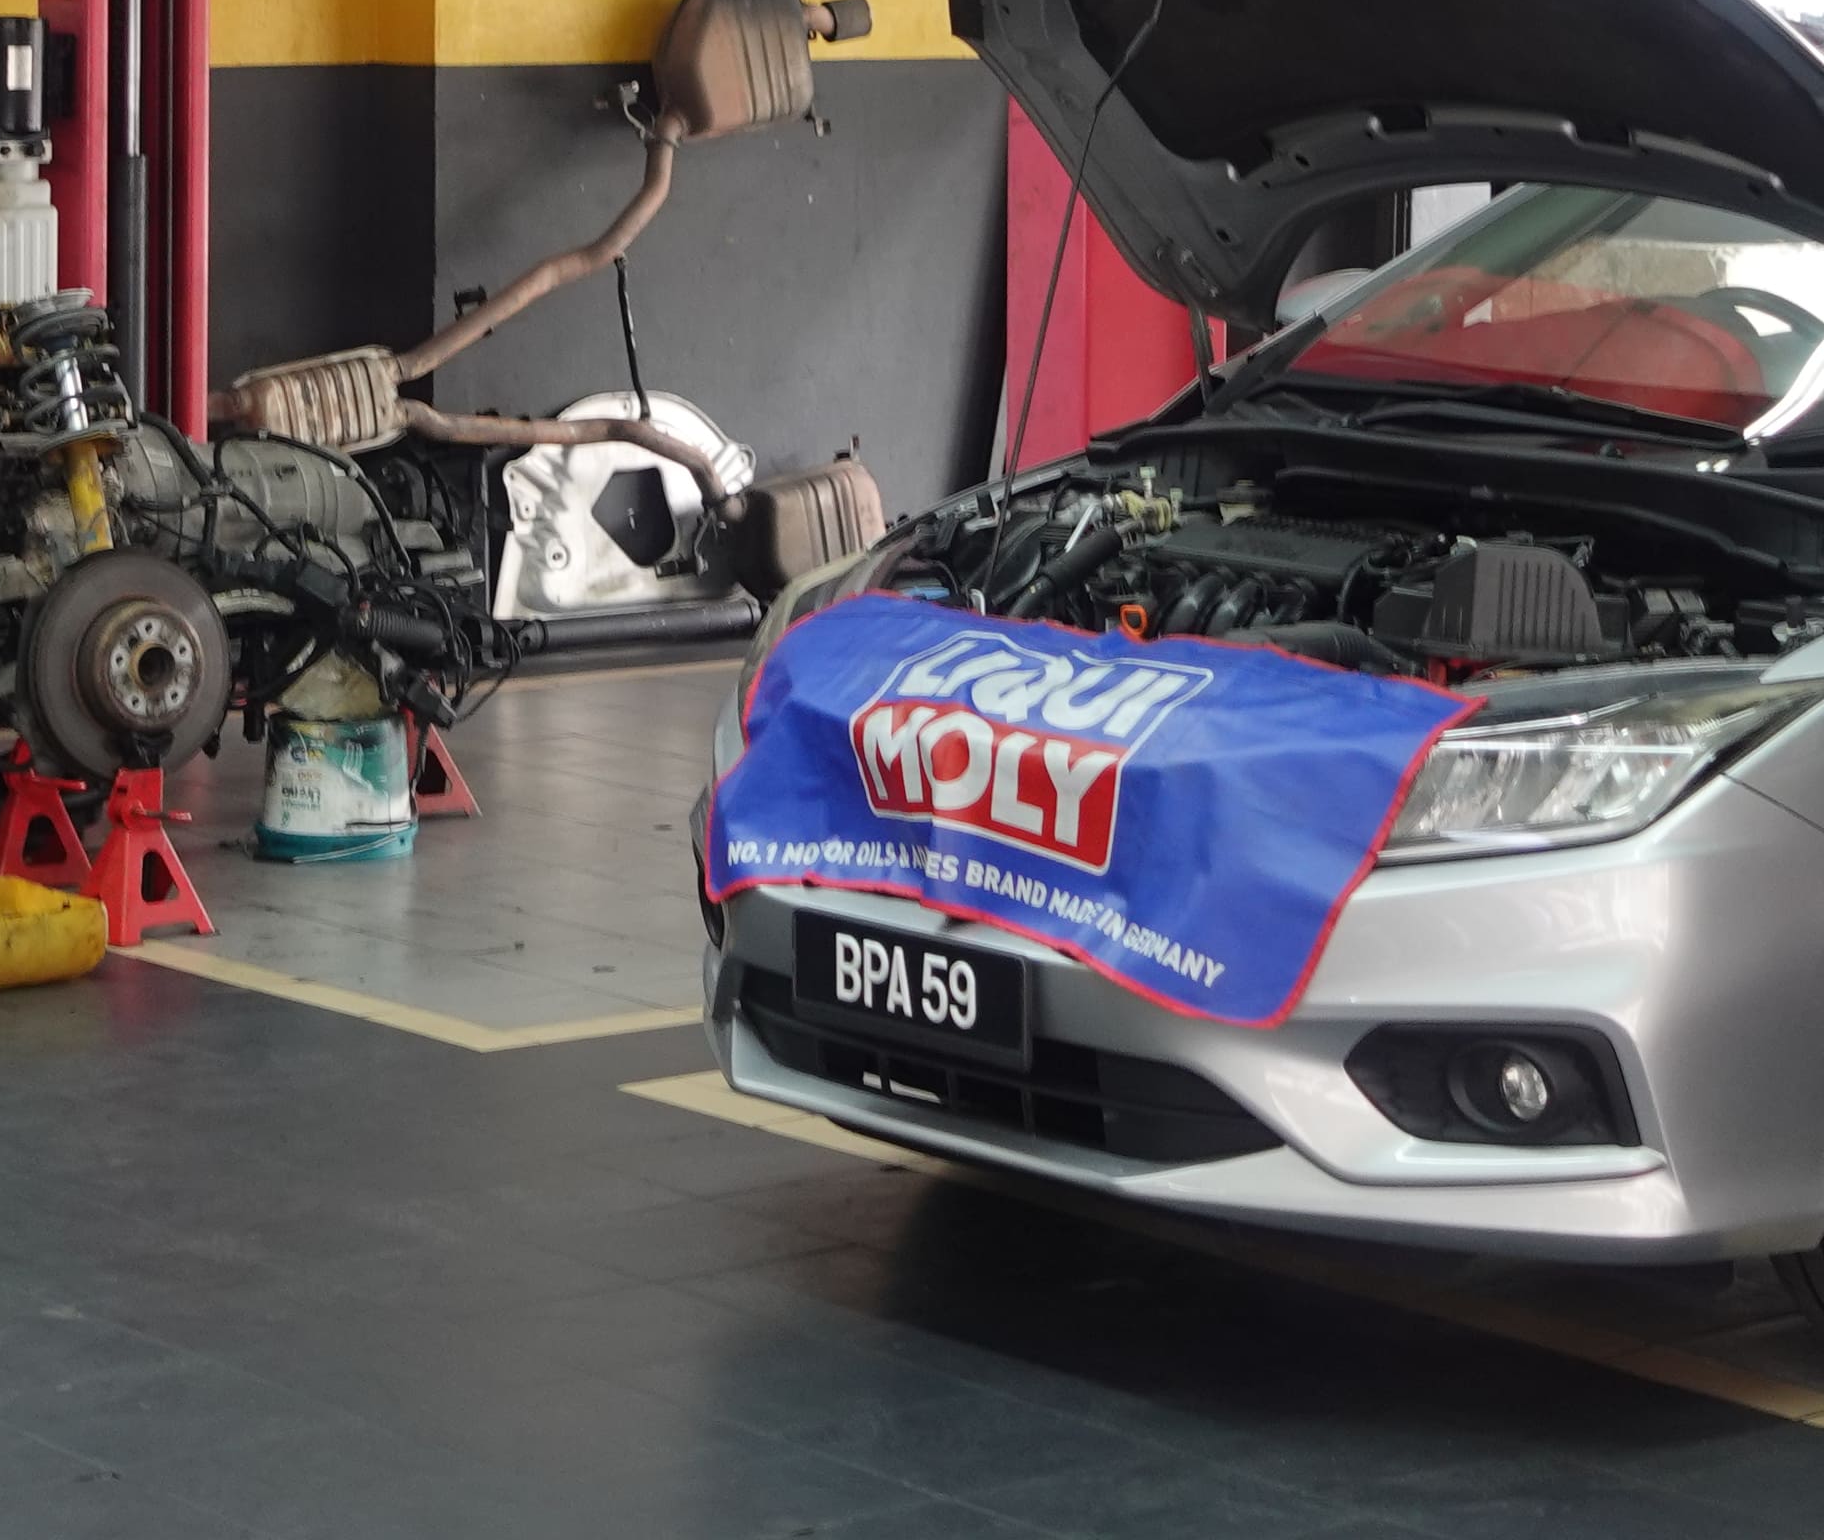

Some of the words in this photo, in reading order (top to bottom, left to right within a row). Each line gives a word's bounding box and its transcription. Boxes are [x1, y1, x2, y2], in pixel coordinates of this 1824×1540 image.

[898, 640, 1189, 738] LIQUI
[864, 706, 1118, 848] MOLY
[728, 840, 761, 867] NO.
[856, 841, 897, 867] OILS
[965, 859, 1048, 909] BRAND
[1096, 908, 1126, 942] IN
[1123, 922, 1226, 988] GERMANY
[835, 932, 913, 1018] BPA
[921, 952, 976, 1030] 59
